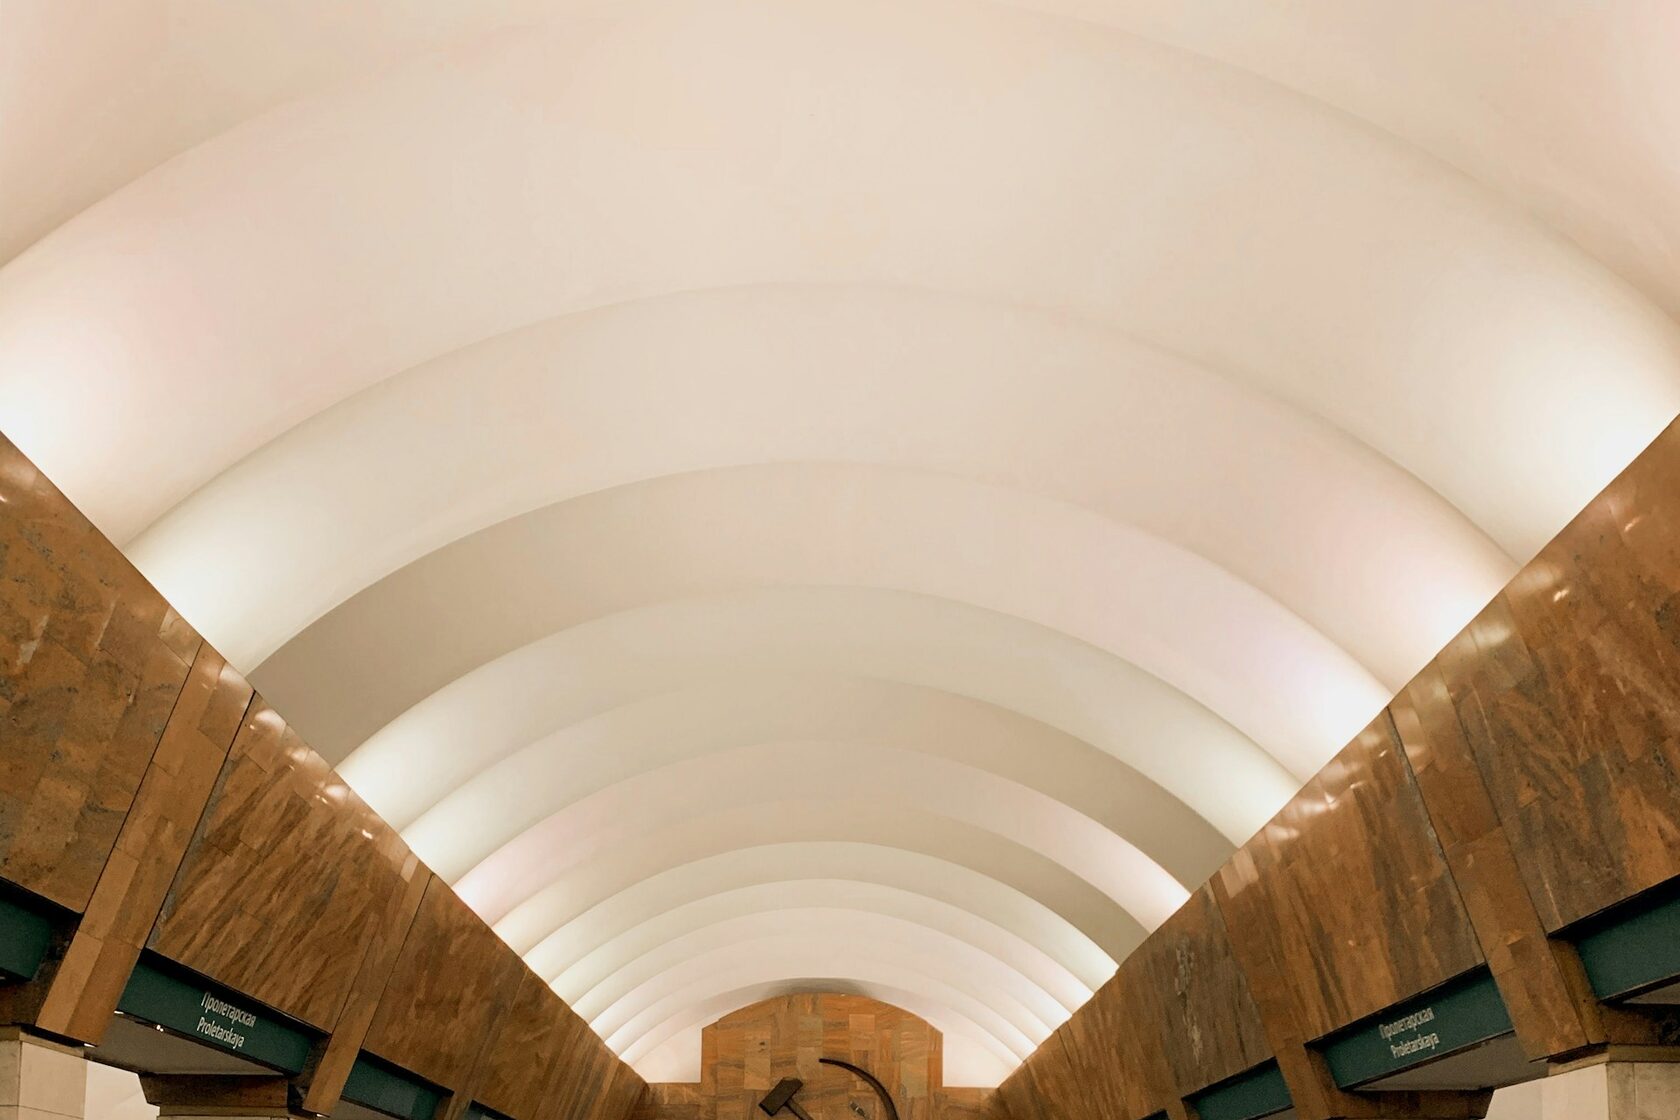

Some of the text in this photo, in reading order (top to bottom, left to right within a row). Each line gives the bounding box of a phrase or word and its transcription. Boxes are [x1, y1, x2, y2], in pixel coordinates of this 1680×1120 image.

[201, 990, 257, 1028] Пролетарская
[196, 1016, 245, 1050] Proletarskaya
[1390, 1032, 1440, 1059] Proletarskaya
